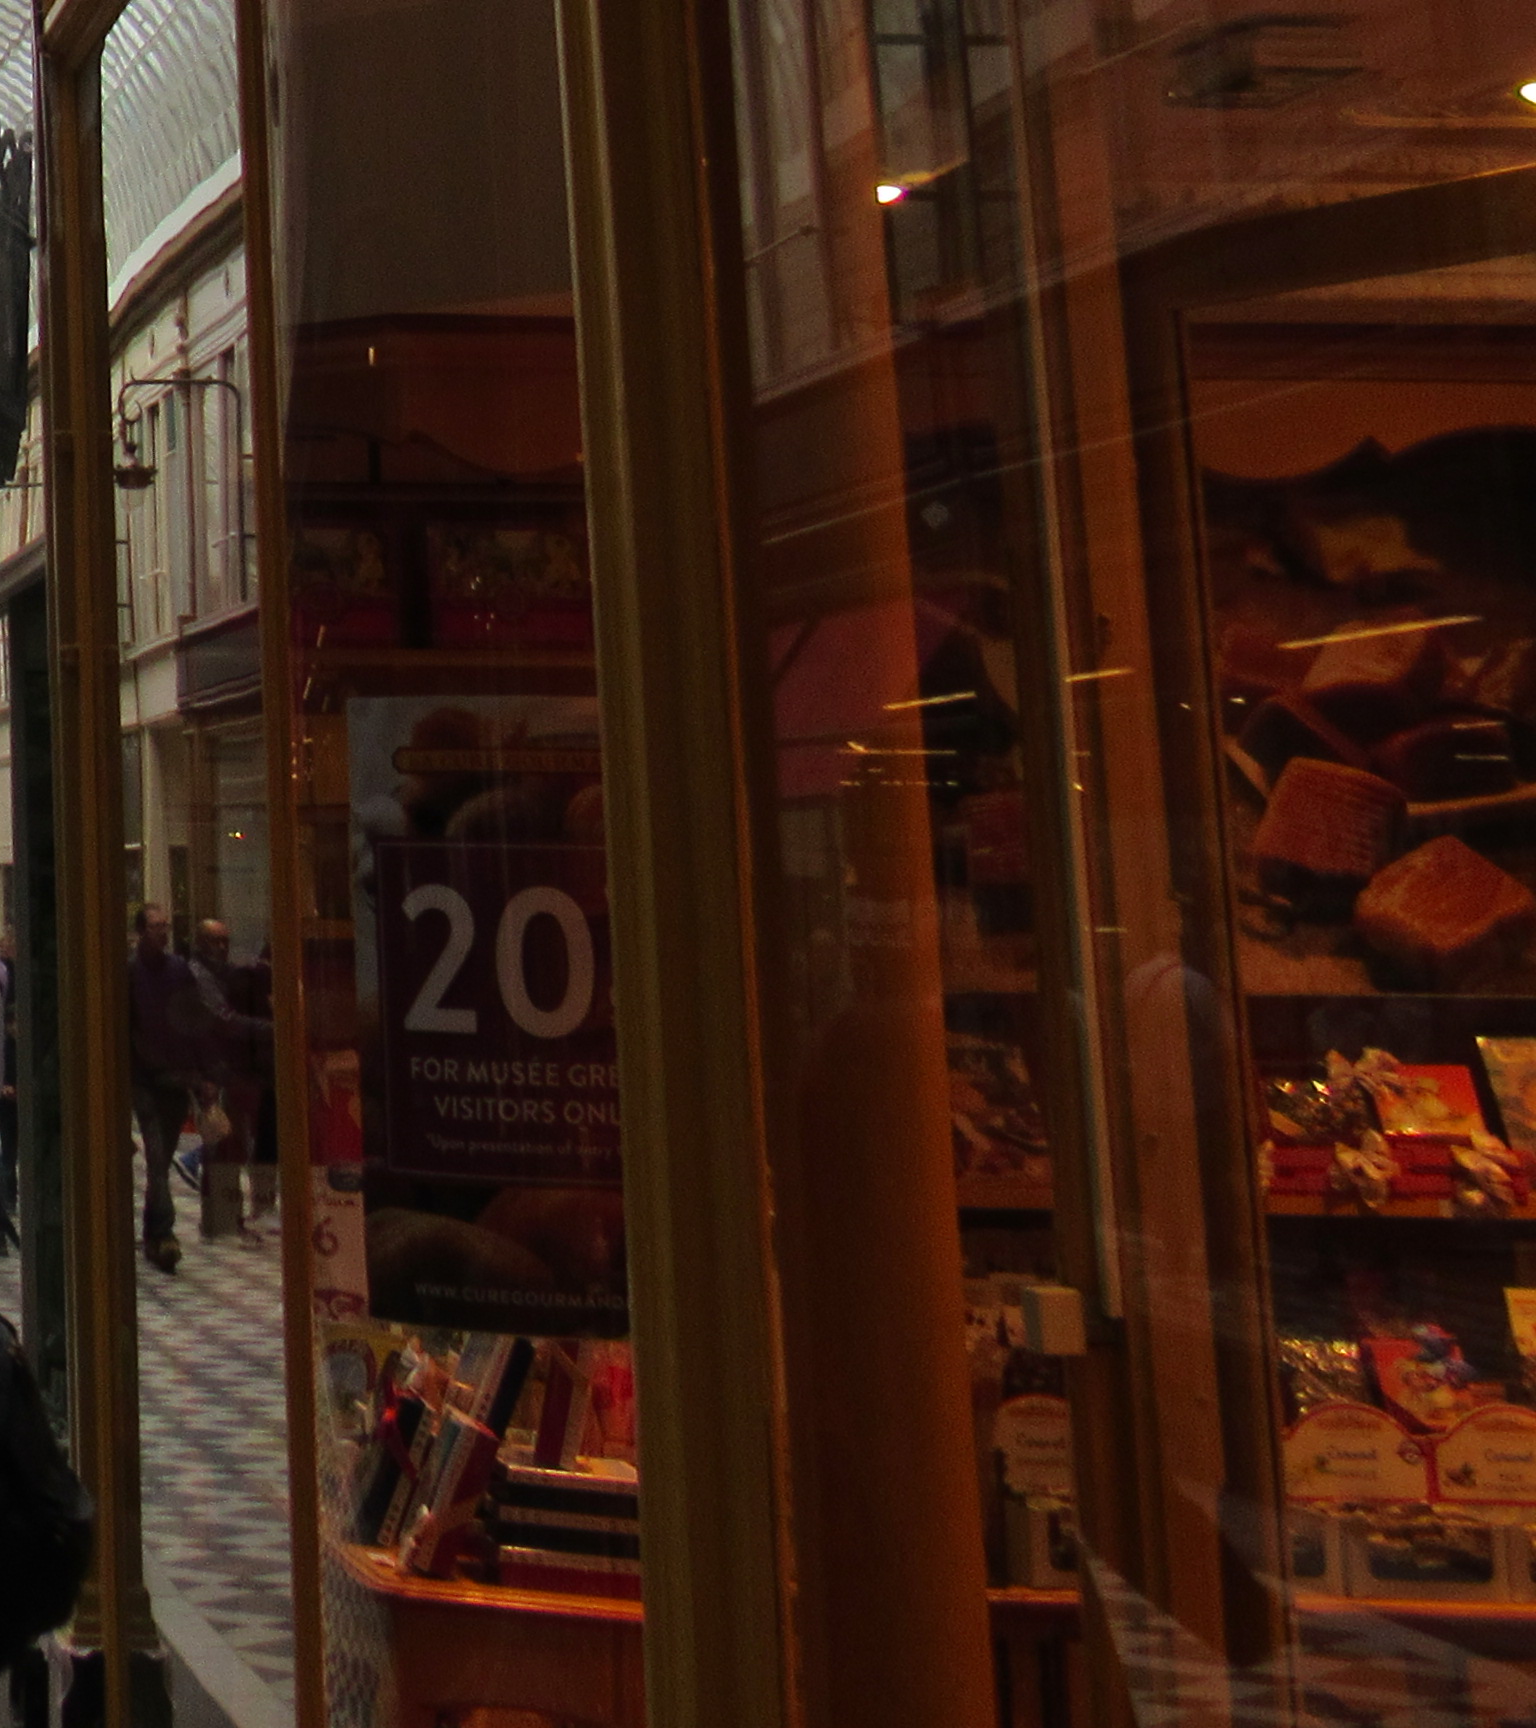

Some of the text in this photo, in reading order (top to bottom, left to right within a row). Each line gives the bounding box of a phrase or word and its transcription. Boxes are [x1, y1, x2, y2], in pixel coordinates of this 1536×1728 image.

[400, 883, 596, 1039] 20
[409, 1056, 460, 1083] FOR
[466, 1055, 560, 1087] MUSÉE
[433, 1094, 556, 1124] VISITORS
[468, 1137, 554, 1158] presentation
